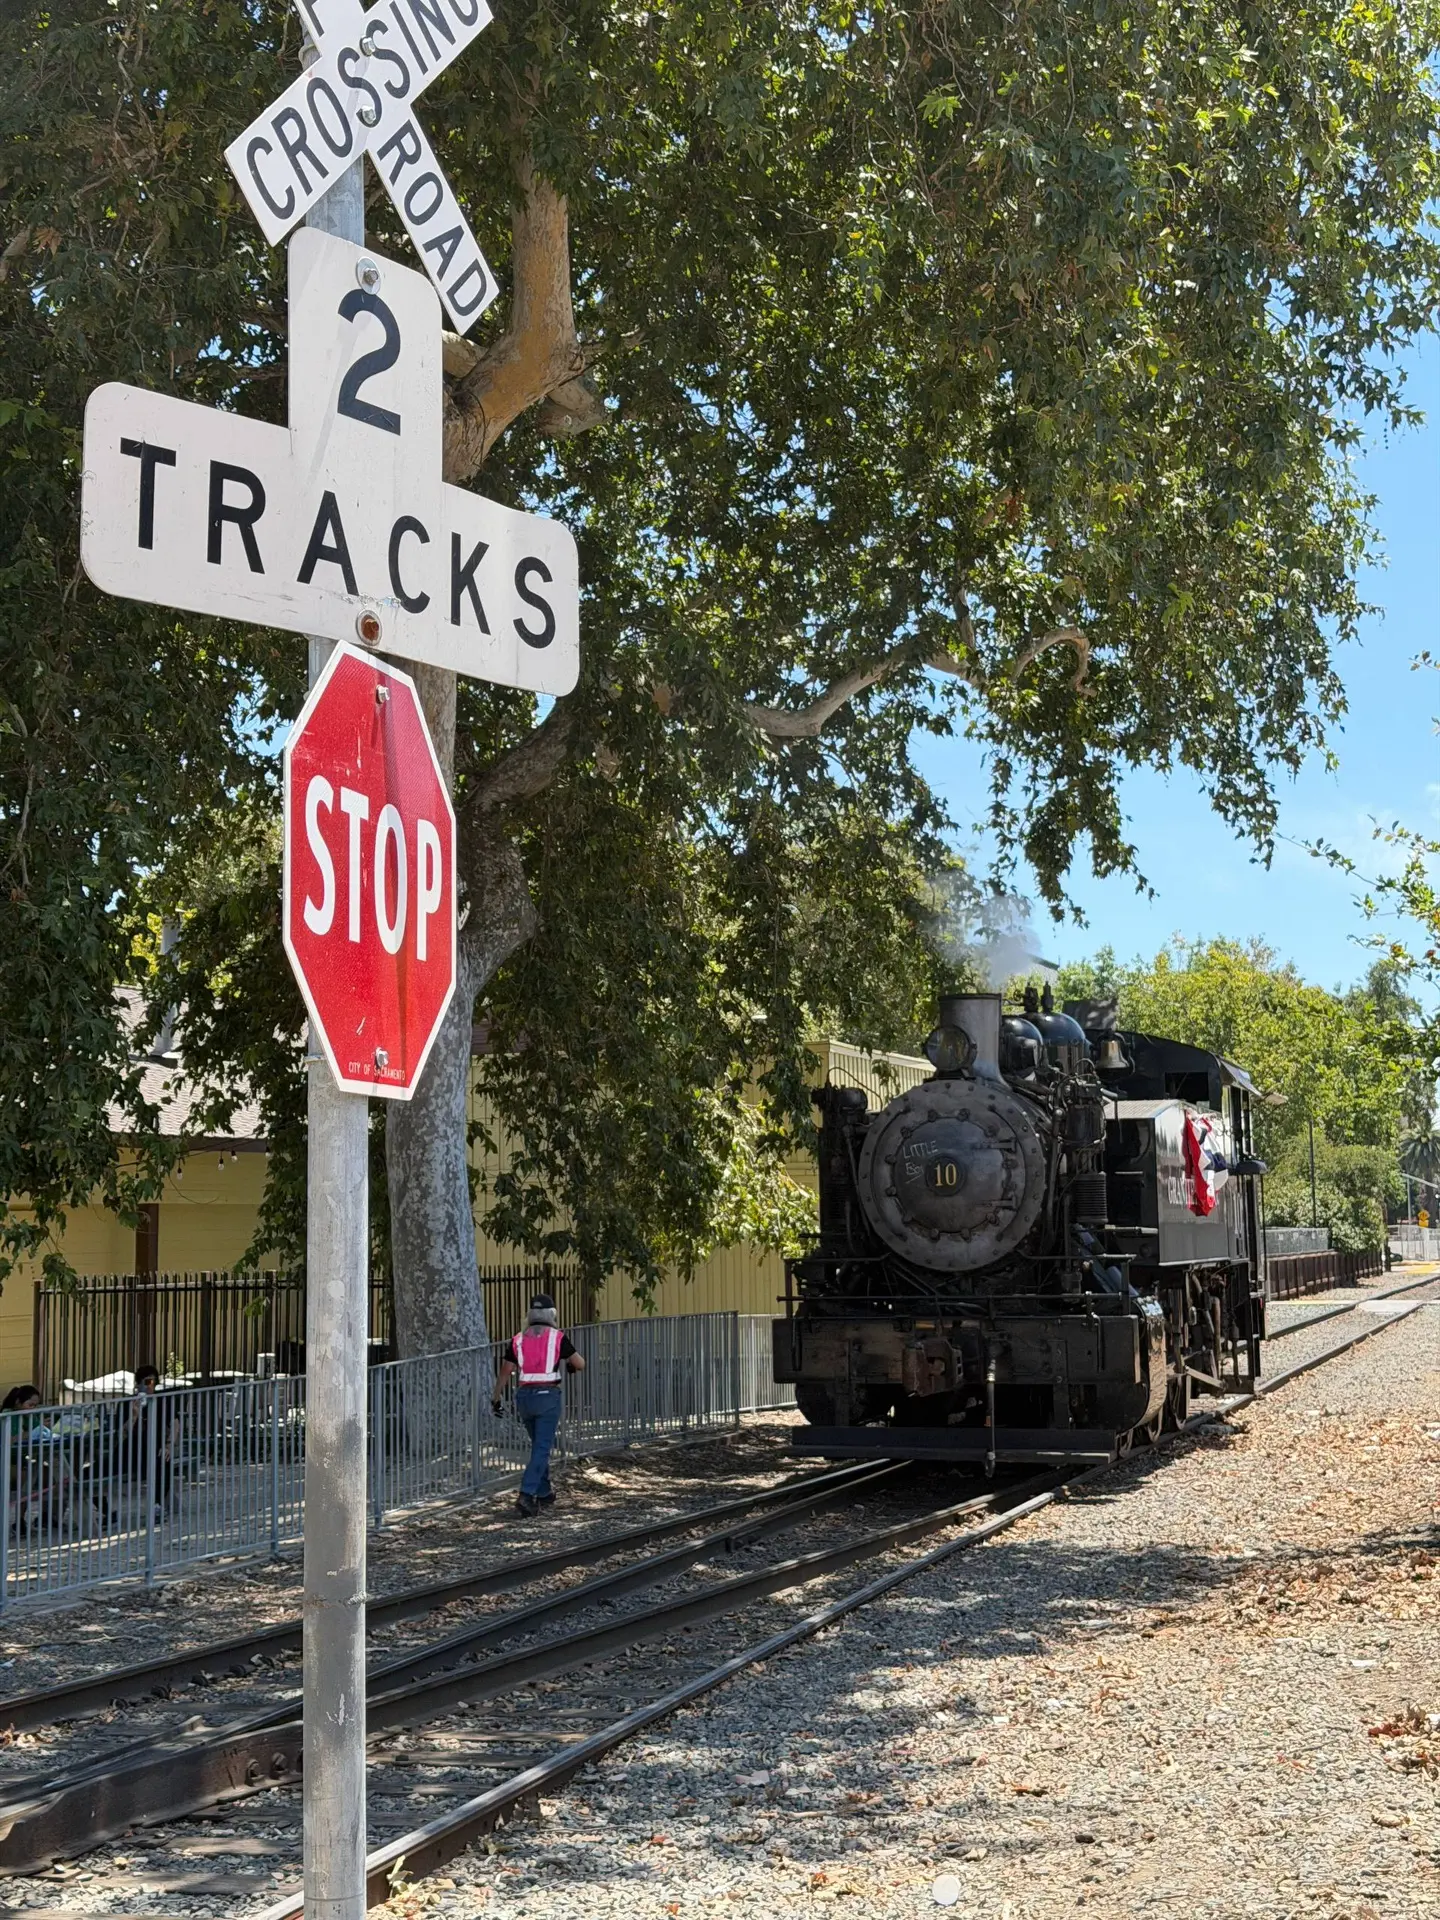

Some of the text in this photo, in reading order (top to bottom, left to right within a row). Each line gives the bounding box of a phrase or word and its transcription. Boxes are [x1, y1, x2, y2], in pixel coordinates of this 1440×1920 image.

[376, 119, 487, 317] ROAD
[338, 288, 401, 436] 2
[120, 437, 556, 649] TRACKS
[303, 774, 442, 962] STOP
[348, 1061, 406, 1081] CITY OF SACRAMENTO
[934, 1162, 957, 1187] 10
